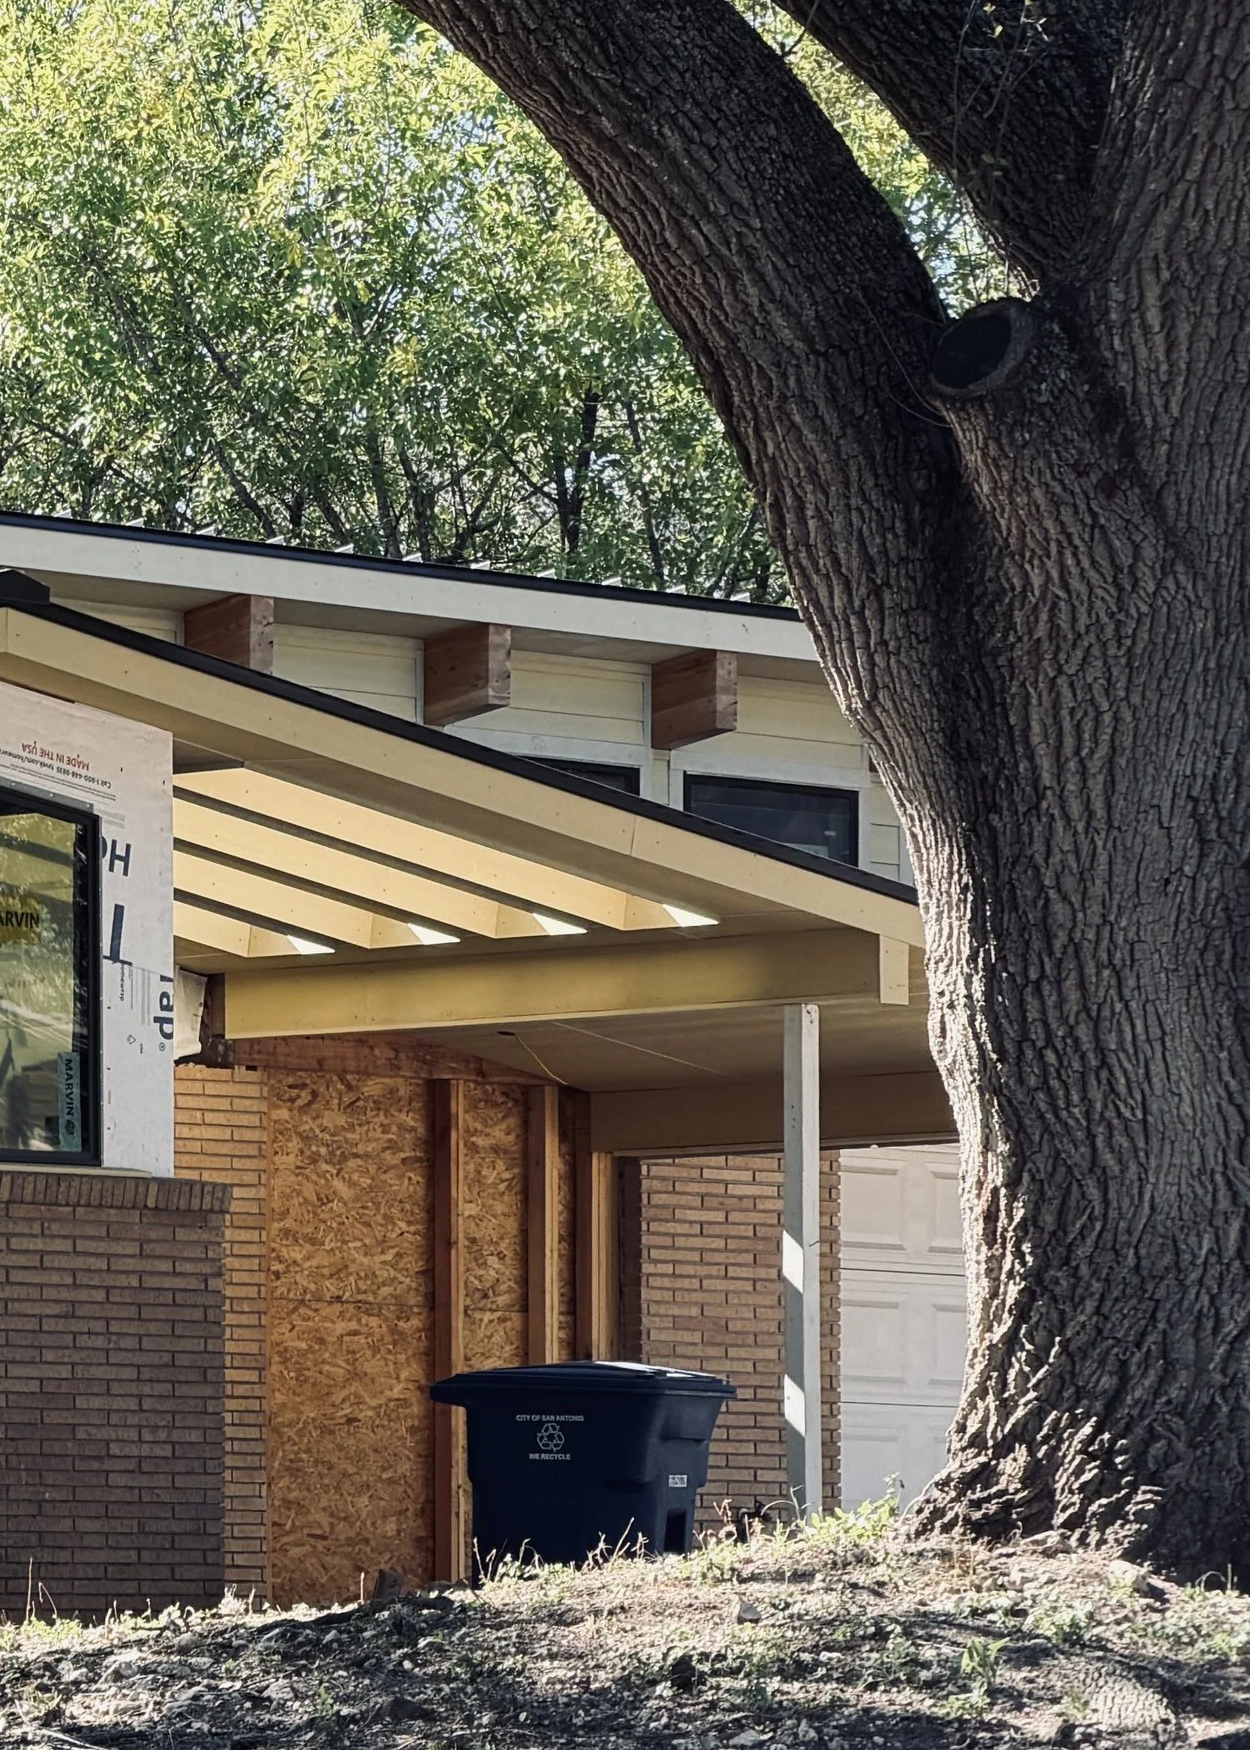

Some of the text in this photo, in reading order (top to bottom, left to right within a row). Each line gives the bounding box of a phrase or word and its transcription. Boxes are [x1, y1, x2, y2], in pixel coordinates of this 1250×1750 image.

[21, 743, 90, 771] MADE IN THE USA
[65, 1058, 75, 1117] MARVIN
